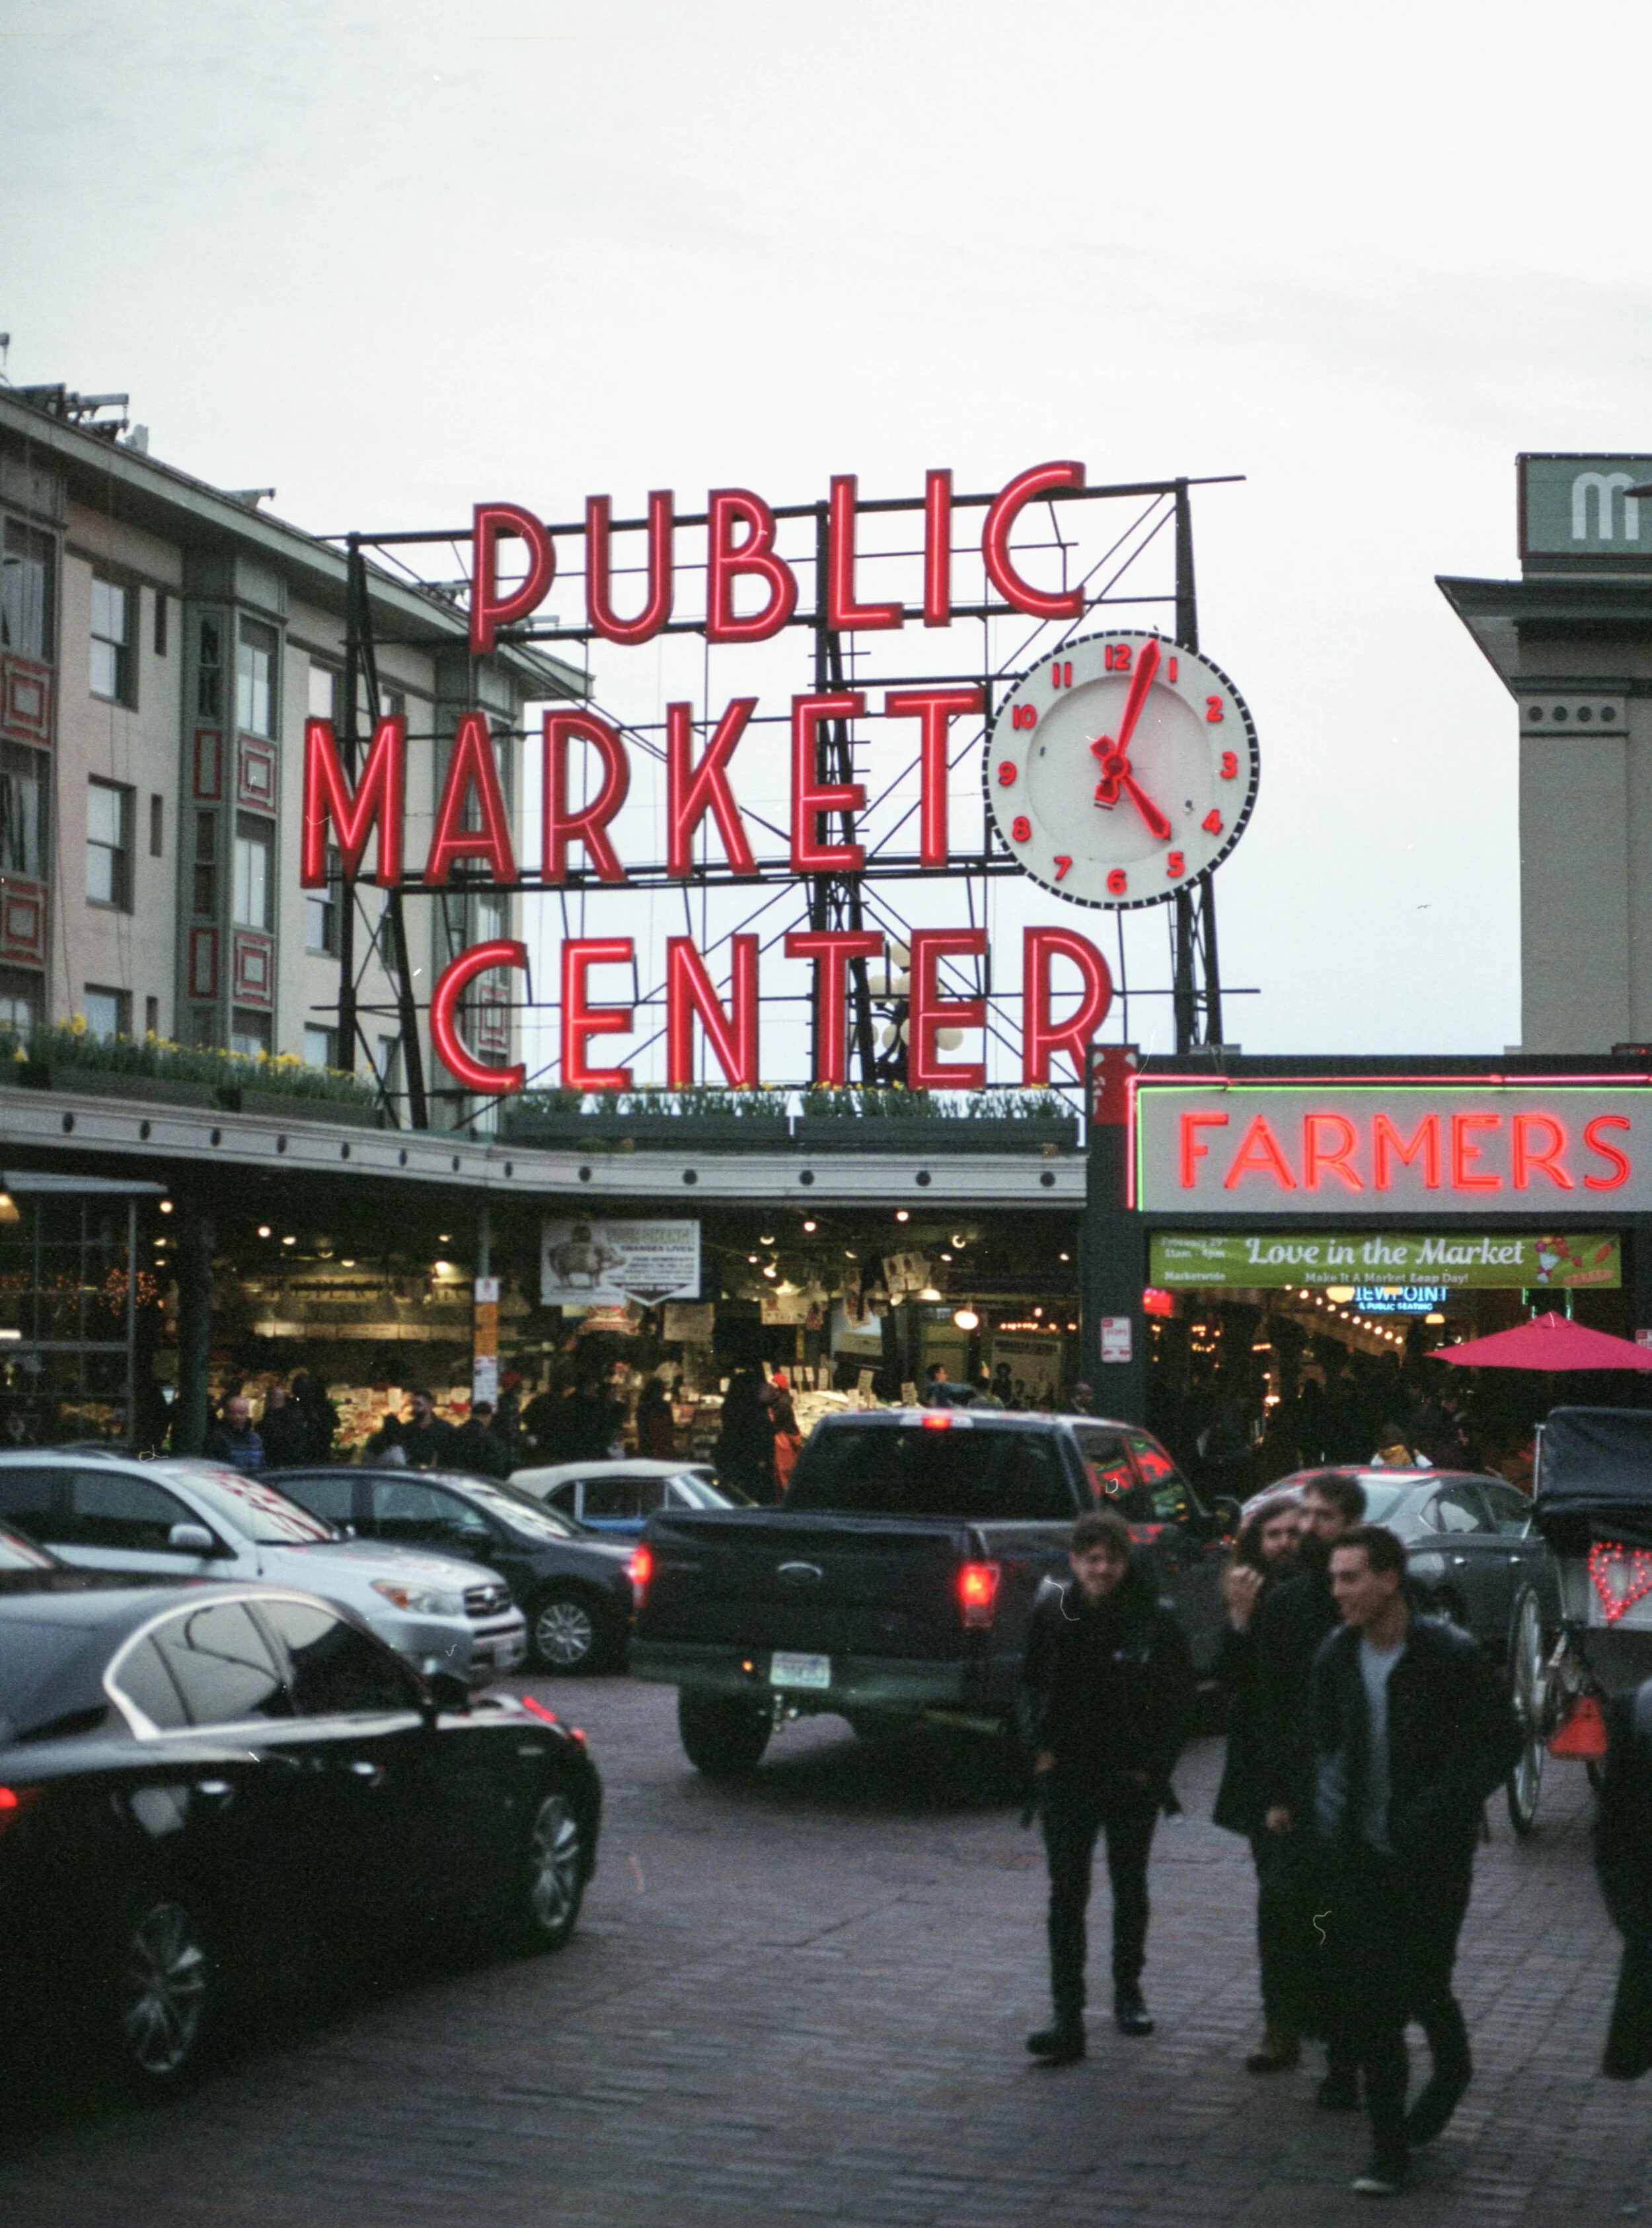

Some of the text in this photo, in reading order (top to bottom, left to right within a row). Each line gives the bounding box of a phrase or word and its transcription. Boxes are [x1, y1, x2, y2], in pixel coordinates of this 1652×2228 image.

[469, 460, 1085, 654] PUBLIC
[1105, 644, 1131, 670] 12
[1169, 657, 1178, 683] 1
[1052, 662, 1072, 688] 11
[1012, 705, 1037, 730] 10
[1206, 695, 1223, 722] 2
[998, 761, 1017, 787] 9
[1220, 751, 1238, 779] 3
[301, 687, 985, 888] MARKET
[1012, 816, 1031, 841] 8
[1202, 808, 1223, 835] 4
[1054, 856, 1072, 881] 7
[1167, 851, 1185, 878] 5
[1106, 868, 1127, 896] 6
[430, 925, 1112, 1094] CENTER
[1180, 1113, 1631, 1190] FARMERS
[1245, 1236, 1524, 1264] Love in the Market
[1304, 1272, 1469, 1285] Make It A Market Leap Day!
[1348, 1286, 1449, 1301] IEWPOINT
